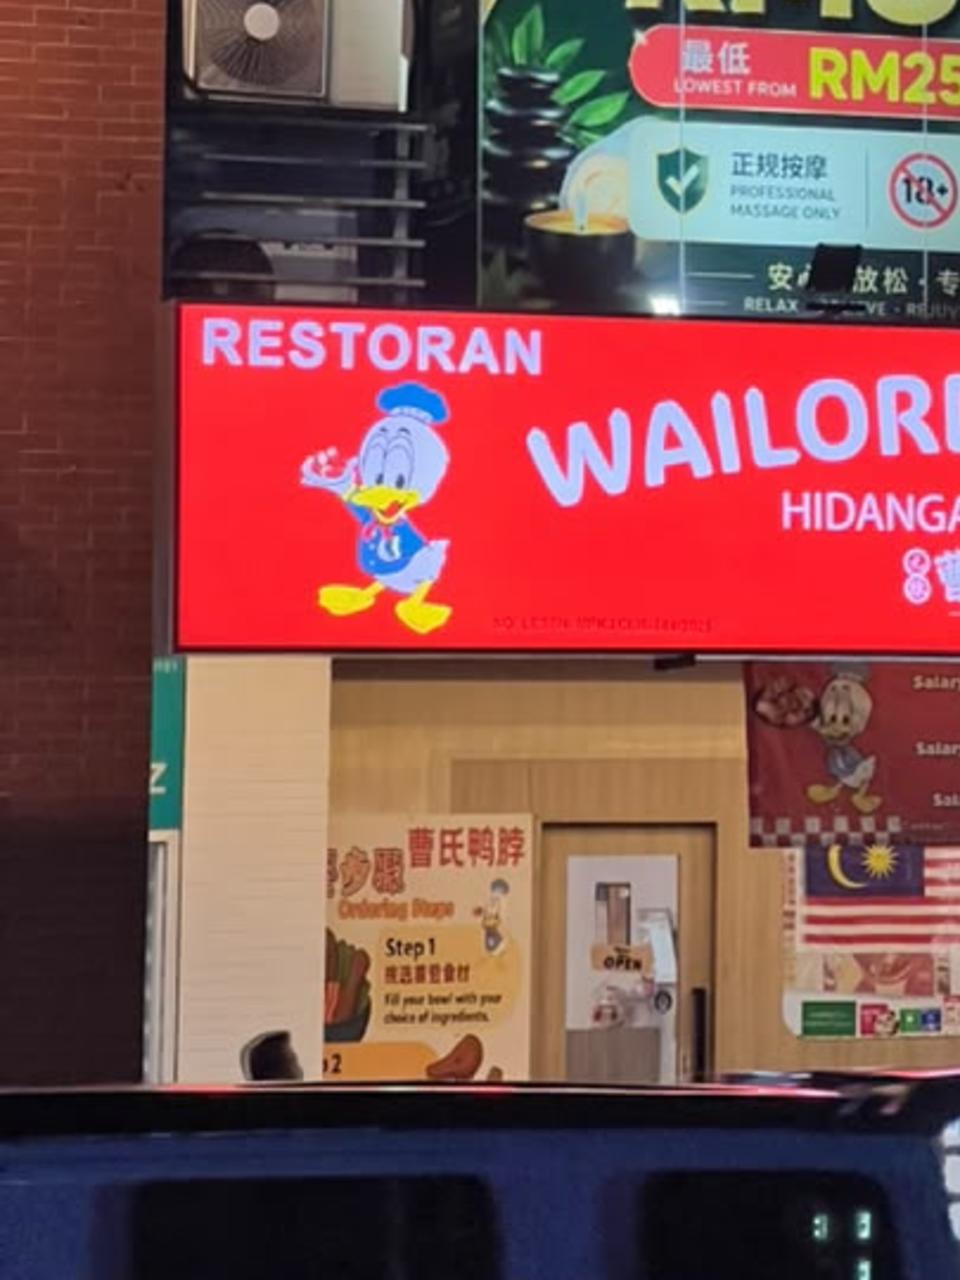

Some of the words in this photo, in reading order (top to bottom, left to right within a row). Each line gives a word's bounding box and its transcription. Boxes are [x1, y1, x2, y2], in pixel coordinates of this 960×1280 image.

[680, 38, 751, 77] 最低
[673, 77, 743, 97] LOWEST
[747, 80, 798, 99] FROM
[729, 150, 830, 182] 正规按摩
[730, 183, 837, 204] PROFESSIONAL
[901, 174, 950, 208] 18+
[730, 202, 799, 221] MASSAGE
[801, 205, 842, 222] ONLY
[852, 265, 910, 296] 放松
[743, 296, 799, 316] RELAX
[201, 317, 544, 376] RESTORAN
[407, 826, 526, 868] 曹氏鸭脖
[385, 937, 425, 961] Step
[428, 937, 436, 955] 1
[603, 954, 643, 972] OPEN
[402, 995, 425, 1008] your
[428, 993, 452, 1006] bowl
[455, 992, 478, 1005] with
[480, 993, 502, 1007] your
[383, 1012, 416, 1025] choice
[418, 1011, 429, 1024] of
[331, 1053, 343, 1073] 2
